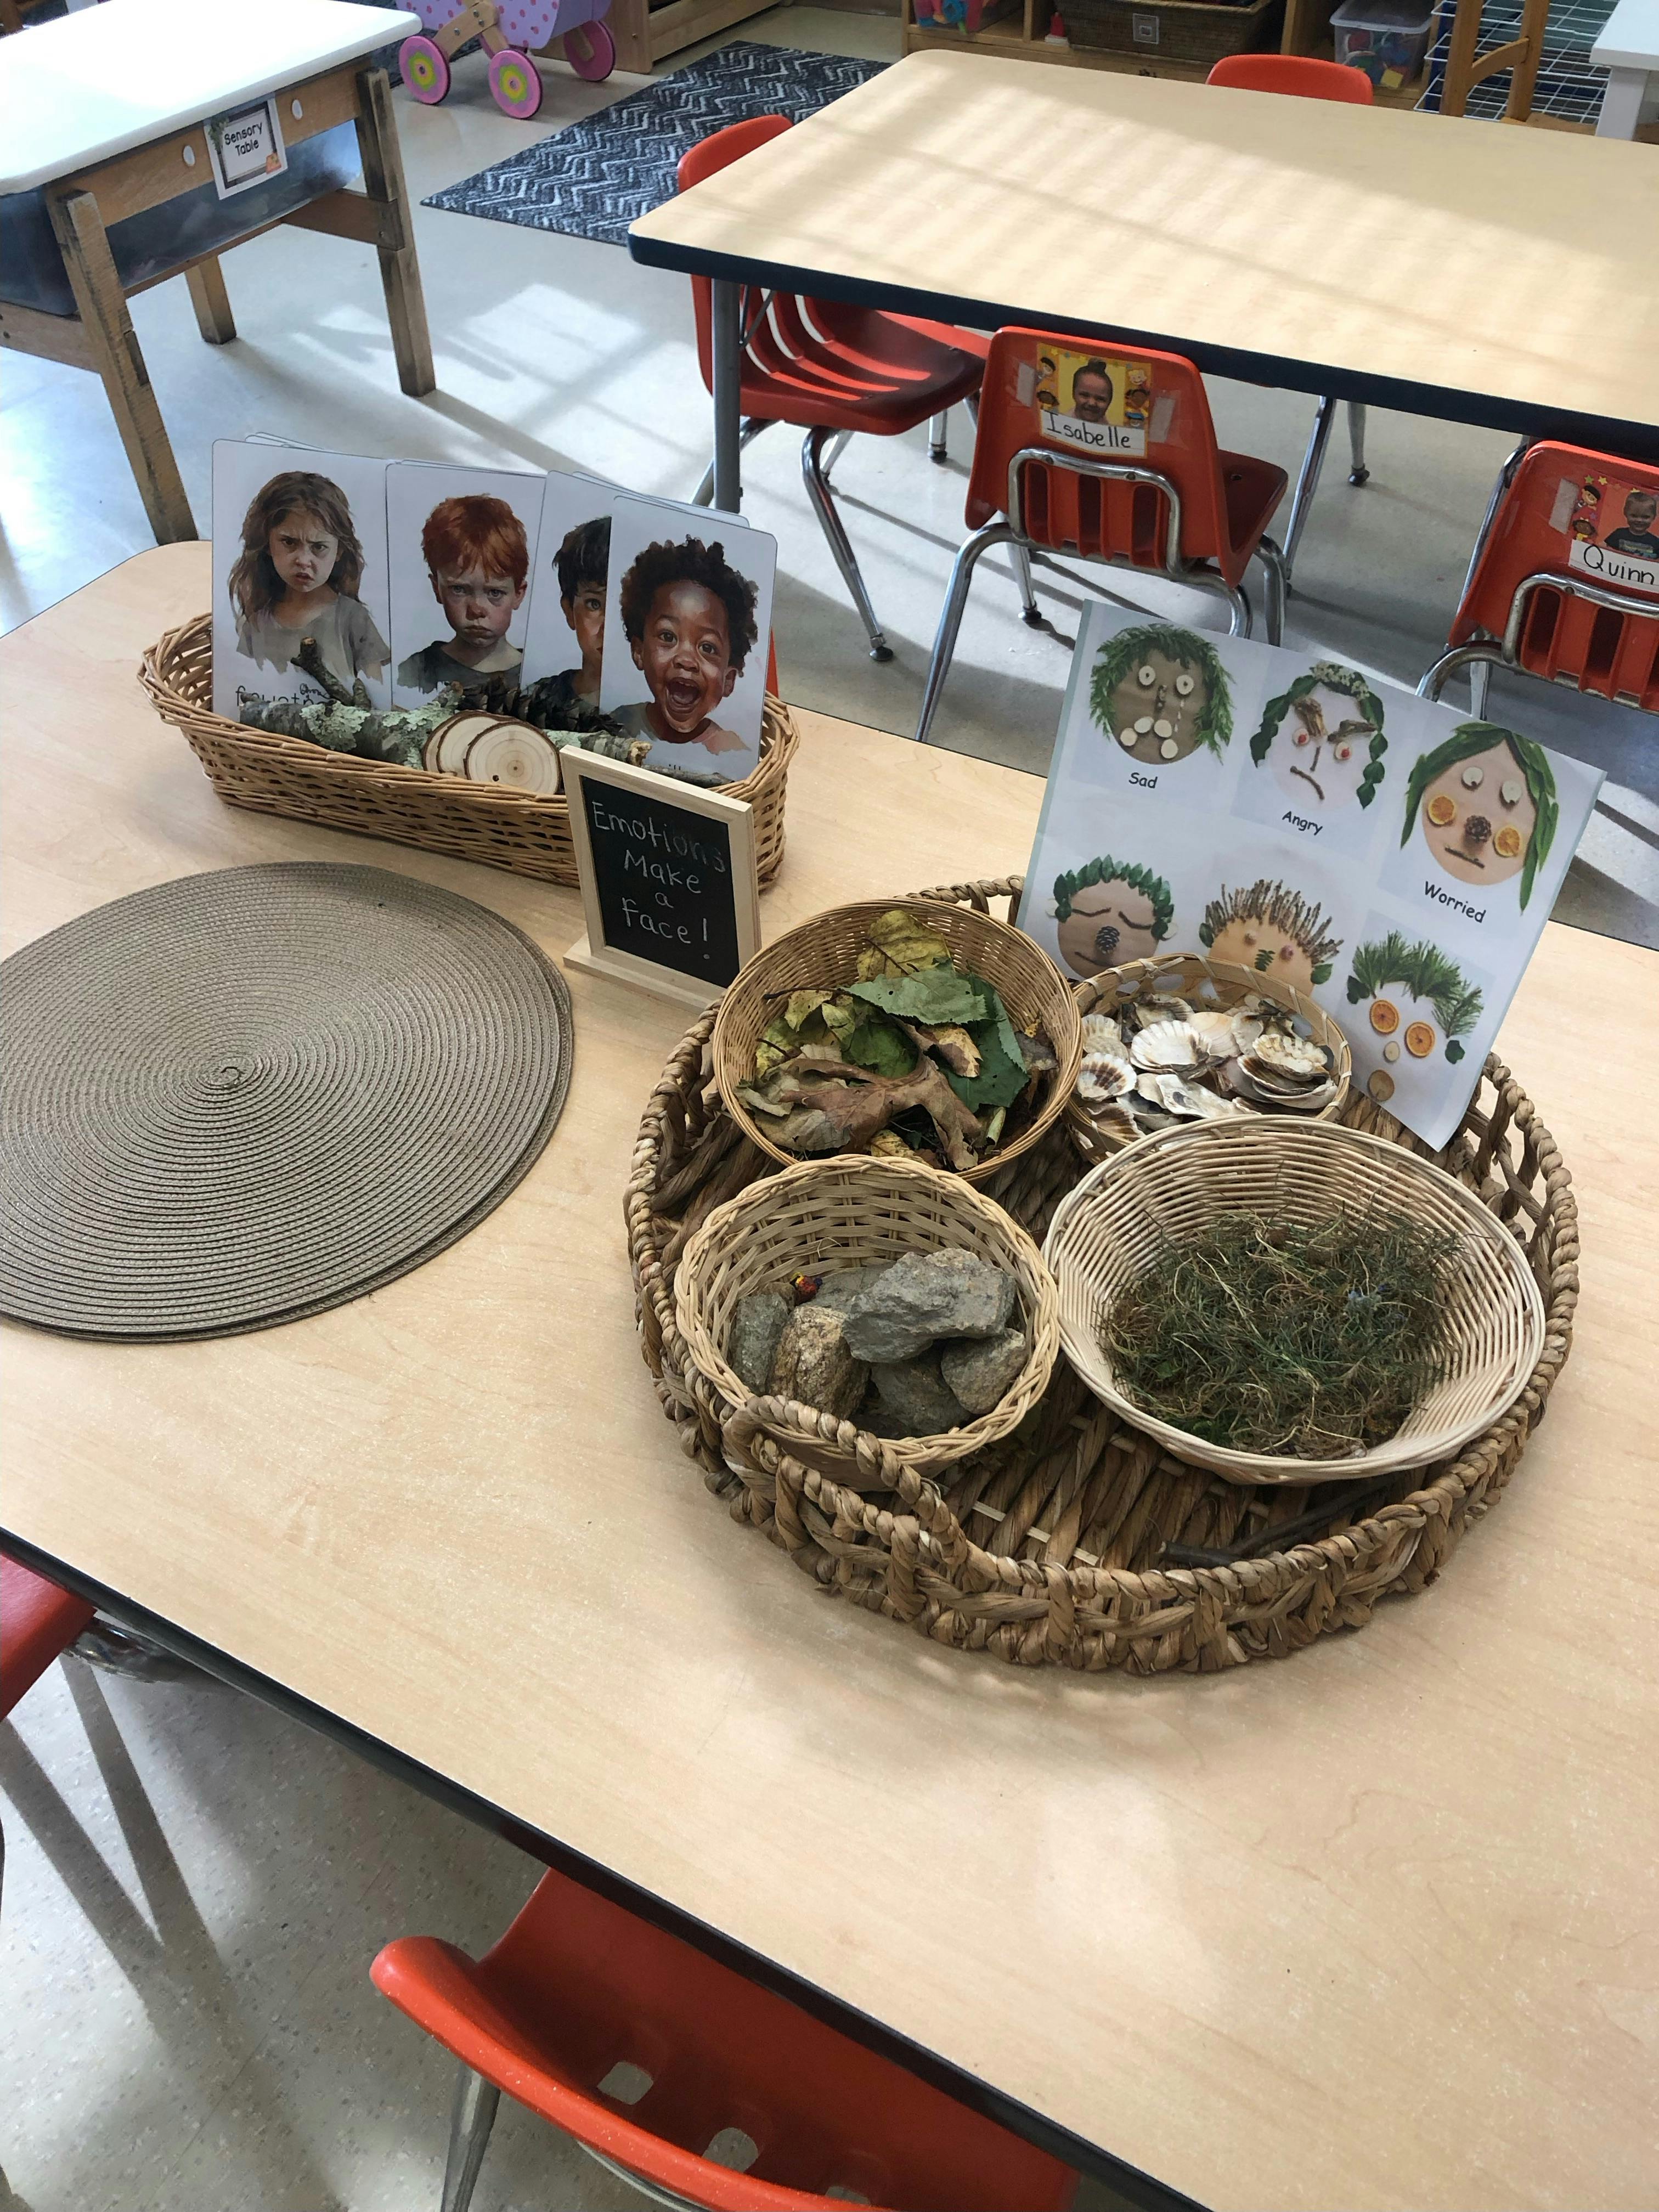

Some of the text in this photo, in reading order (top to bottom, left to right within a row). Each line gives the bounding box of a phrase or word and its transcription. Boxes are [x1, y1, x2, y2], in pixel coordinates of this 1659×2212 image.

[224, 122, 262, 145] Sensory
[235, 139, 259, 156] Table
[1043, 409, 1131, 449] Isabelle
[1583, 544, 1655, 585] Quinn
[1128, 772, 1158, 789] Sad
[591, 800, 725, 873] Emotions
[1282, 811, 1323, 836] Angry
[624, 849, 701, 894] Make
[654, 892, 674, 909] a
[1425, 881, 1486, 923] Worried
